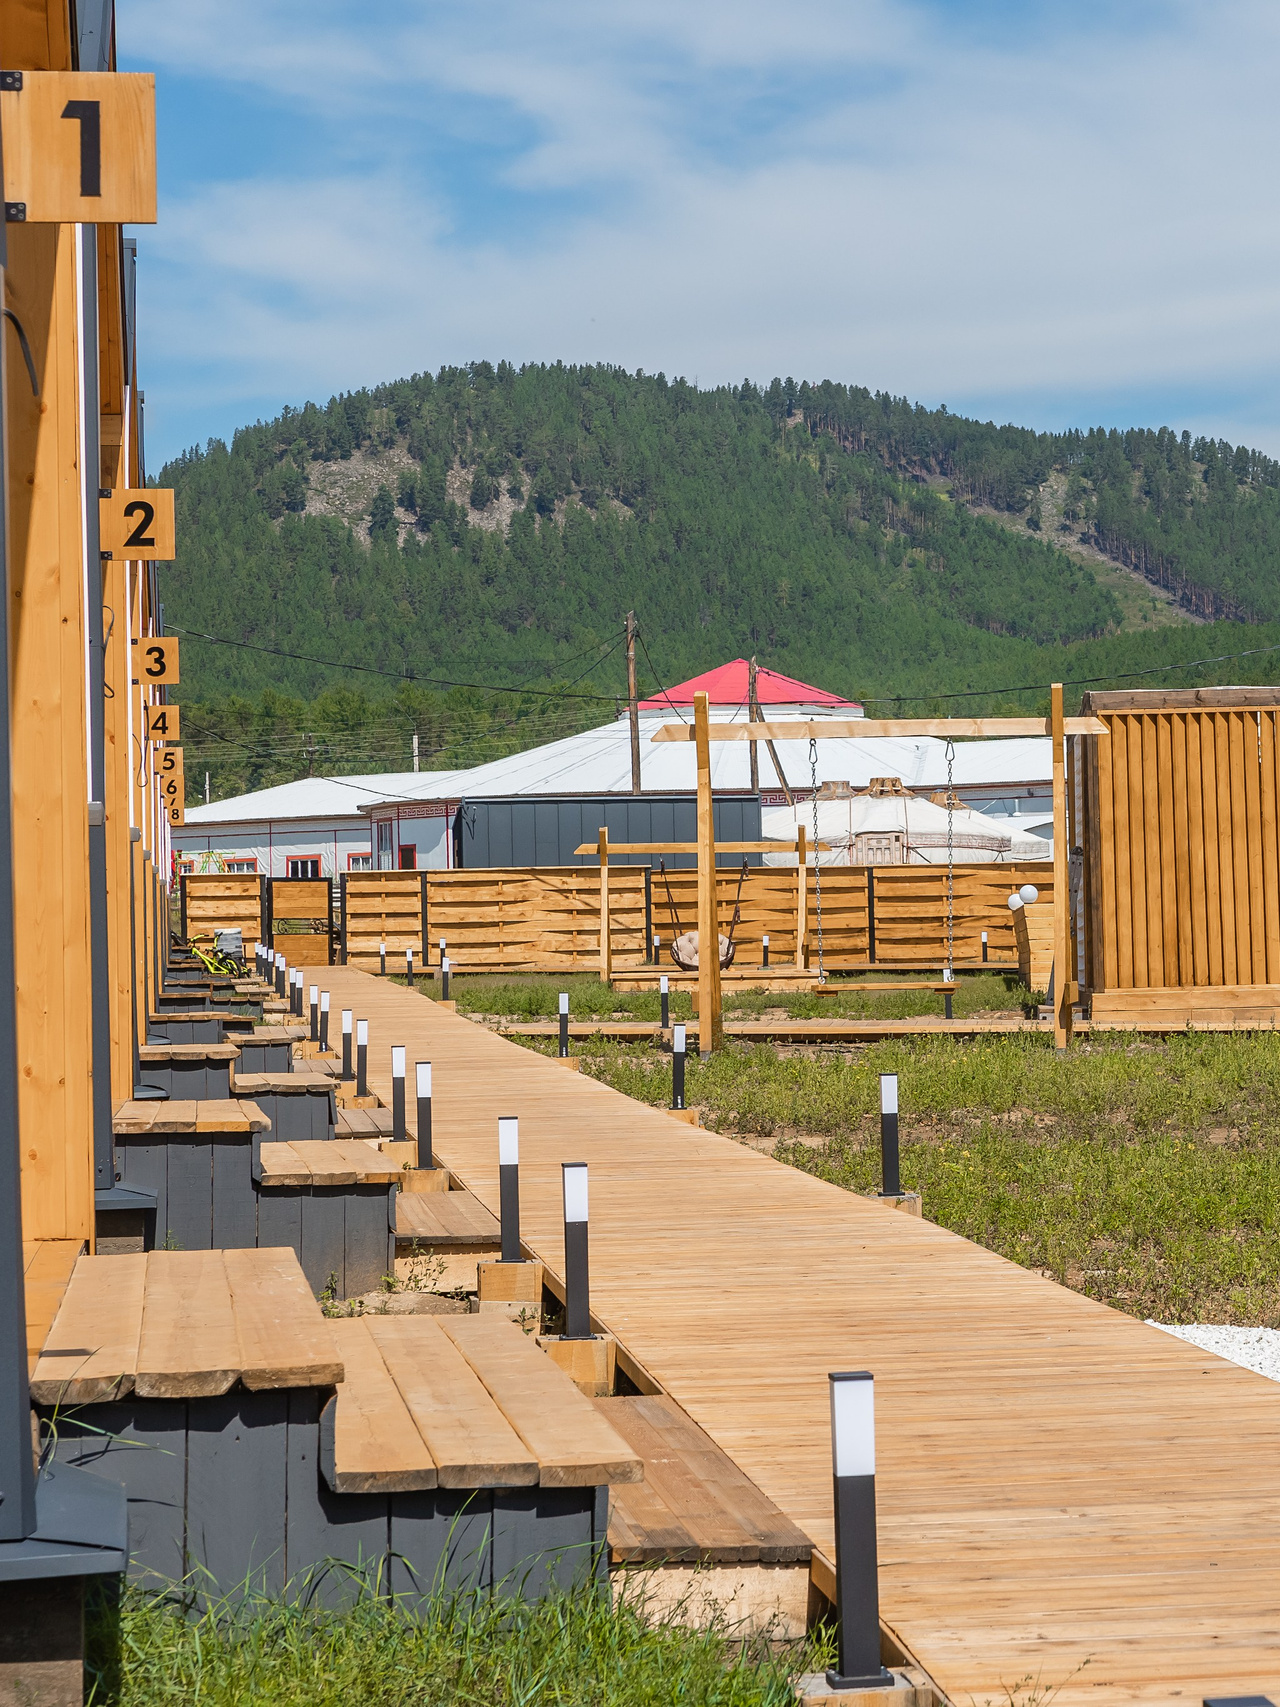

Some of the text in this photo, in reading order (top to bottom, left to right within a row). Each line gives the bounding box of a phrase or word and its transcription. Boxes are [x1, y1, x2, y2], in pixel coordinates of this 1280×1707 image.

[60, 100, 102, 198] 1
[123, 501, 156, 547] 2
[145, 647, 167, 677] 3
[151, 712, 168, 735] 4
[162, 752, 175, 770] 5
[166, 780, 177, 794] 6
[171, 808, 180, 820] 8
